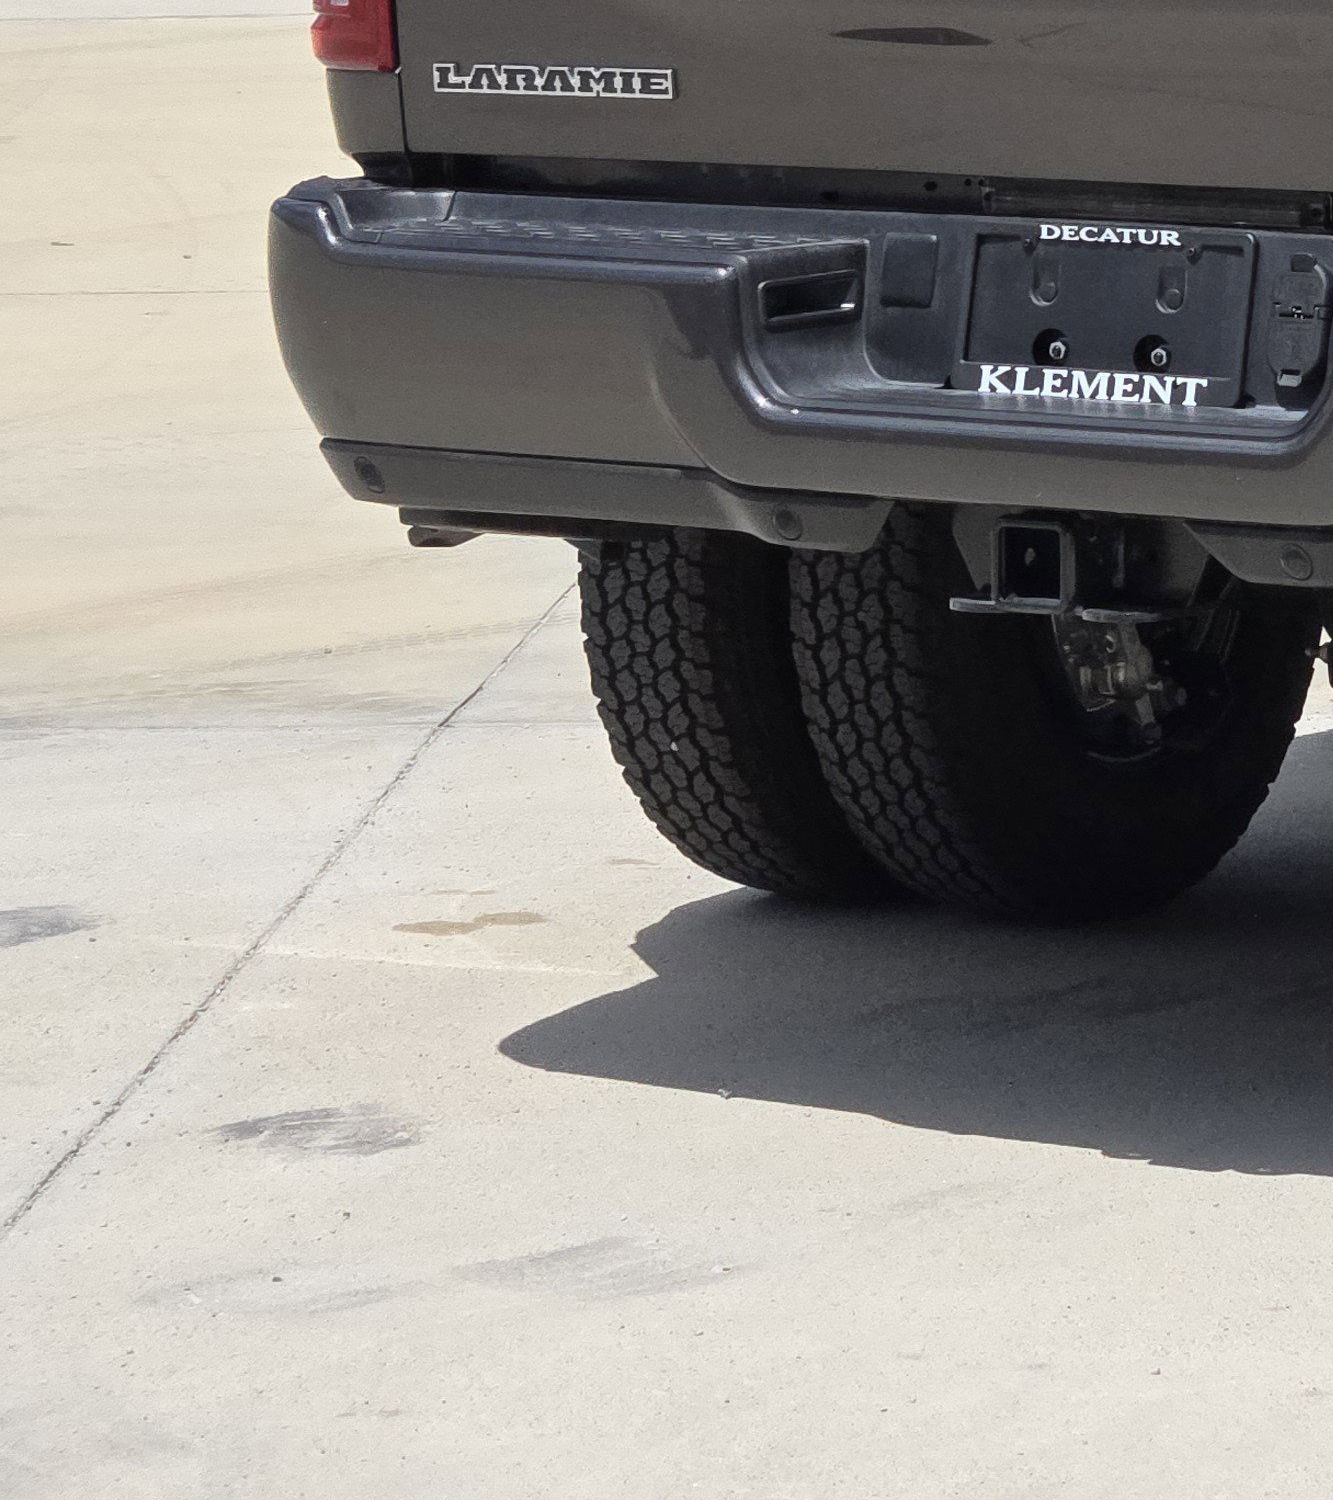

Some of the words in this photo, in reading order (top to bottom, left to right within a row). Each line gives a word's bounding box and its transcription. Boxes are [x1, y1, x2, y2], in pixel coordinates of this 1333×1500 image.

[432, 63, 675, 100] LARAMIE
[1039, 223, 1182, 247] DECATUR
[978, 365, 1208, 407] KLEMENT
